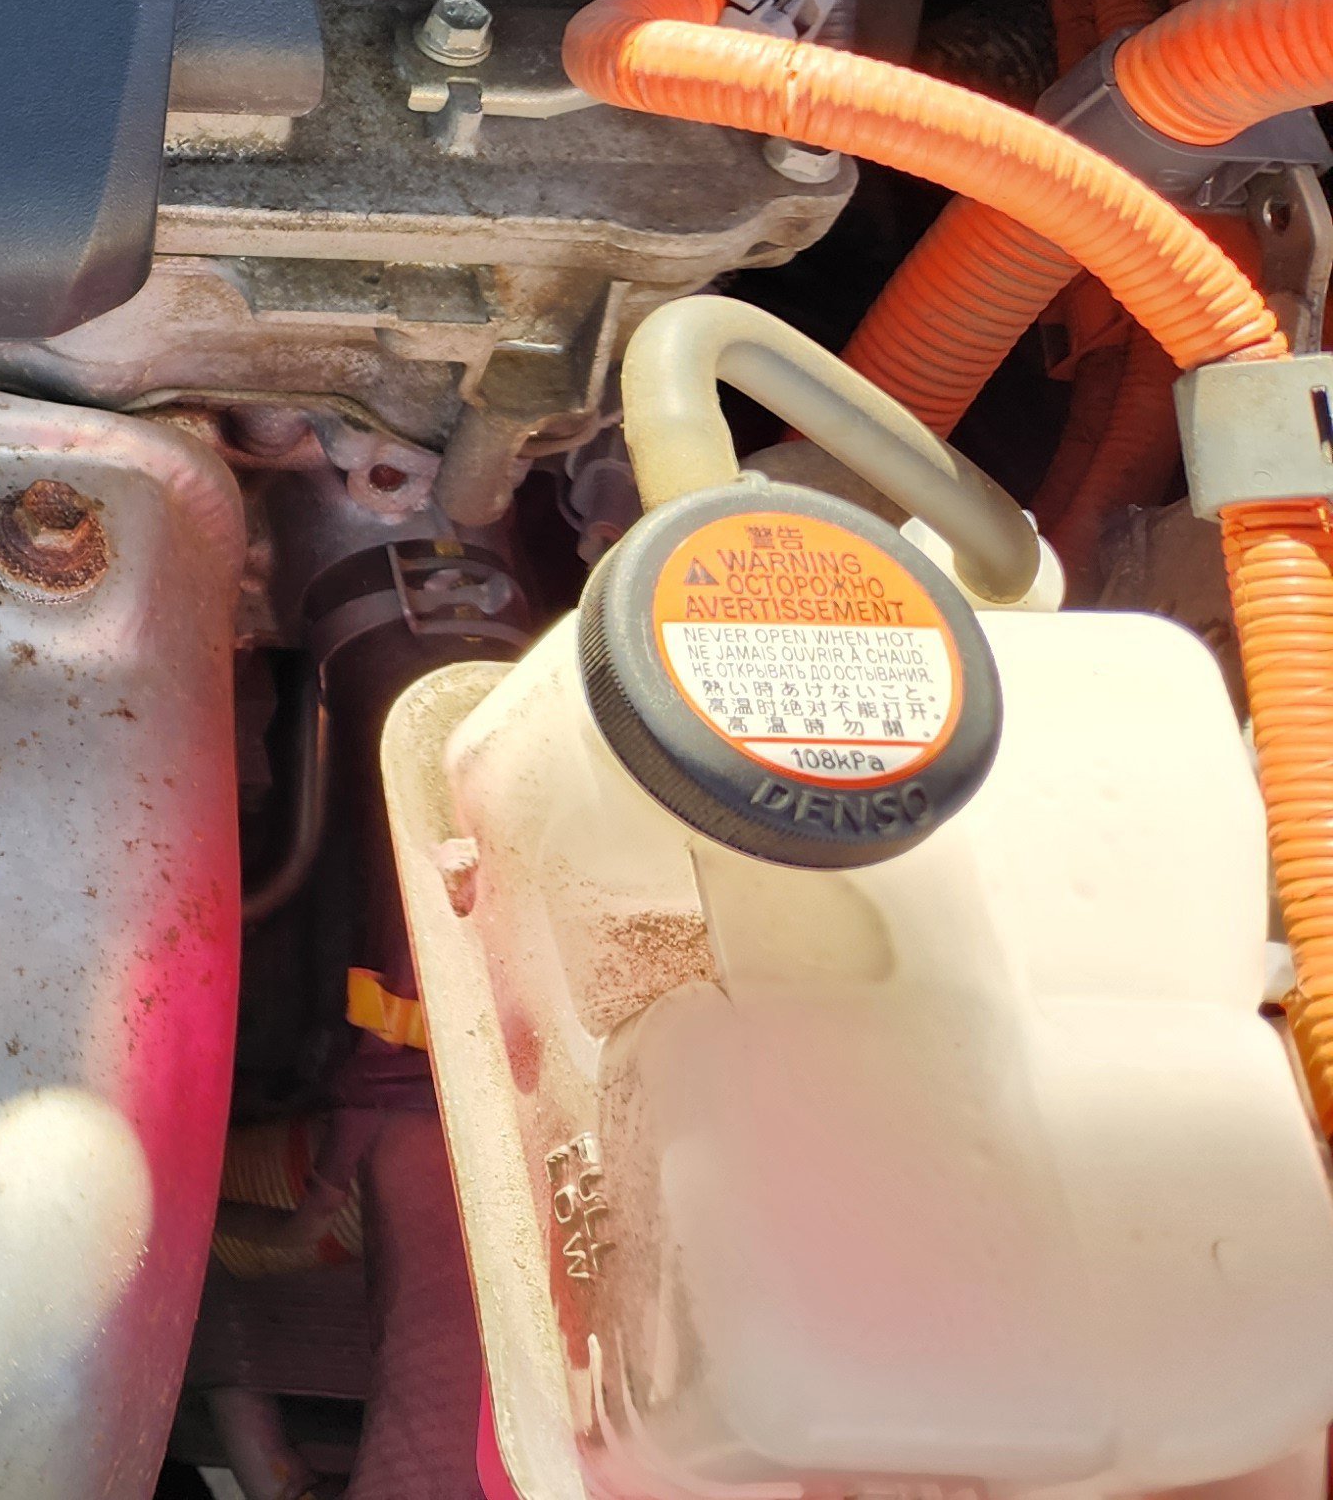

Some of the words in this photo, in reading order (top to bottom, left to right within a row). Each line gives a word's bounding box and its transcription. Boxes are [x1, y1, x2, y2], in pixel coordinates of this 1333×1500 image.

[746, 525, 803, 550] 警告
[716, 549, 862, 575] WARNING
[727, 573, 885, 599] ОСТОРОЖНО
[685, 595, 904, 624] AVERTISSEMENT
[683, 627, 749, 643] NEVER
[754, 628, 807, 645] OPEN
[811, 629, 870, 646] WHEN
[875, 631, 923, 649] HOT.
[687, 644, 711, 661] NE
[716, 645, 777, 661] JAMAIS
[781, 646, 846, 663] OUVRIR
[849, 643, 863, 663] À
[866, 648, 929, 666] CHAUD.
[691, 662, 713, 678] НЕ
[717, 662, 806, 679] ОТКРЫВАТЬ
[790, 747, 887, 772] 108kPa
[750, 777, 930, 834] DENSO
